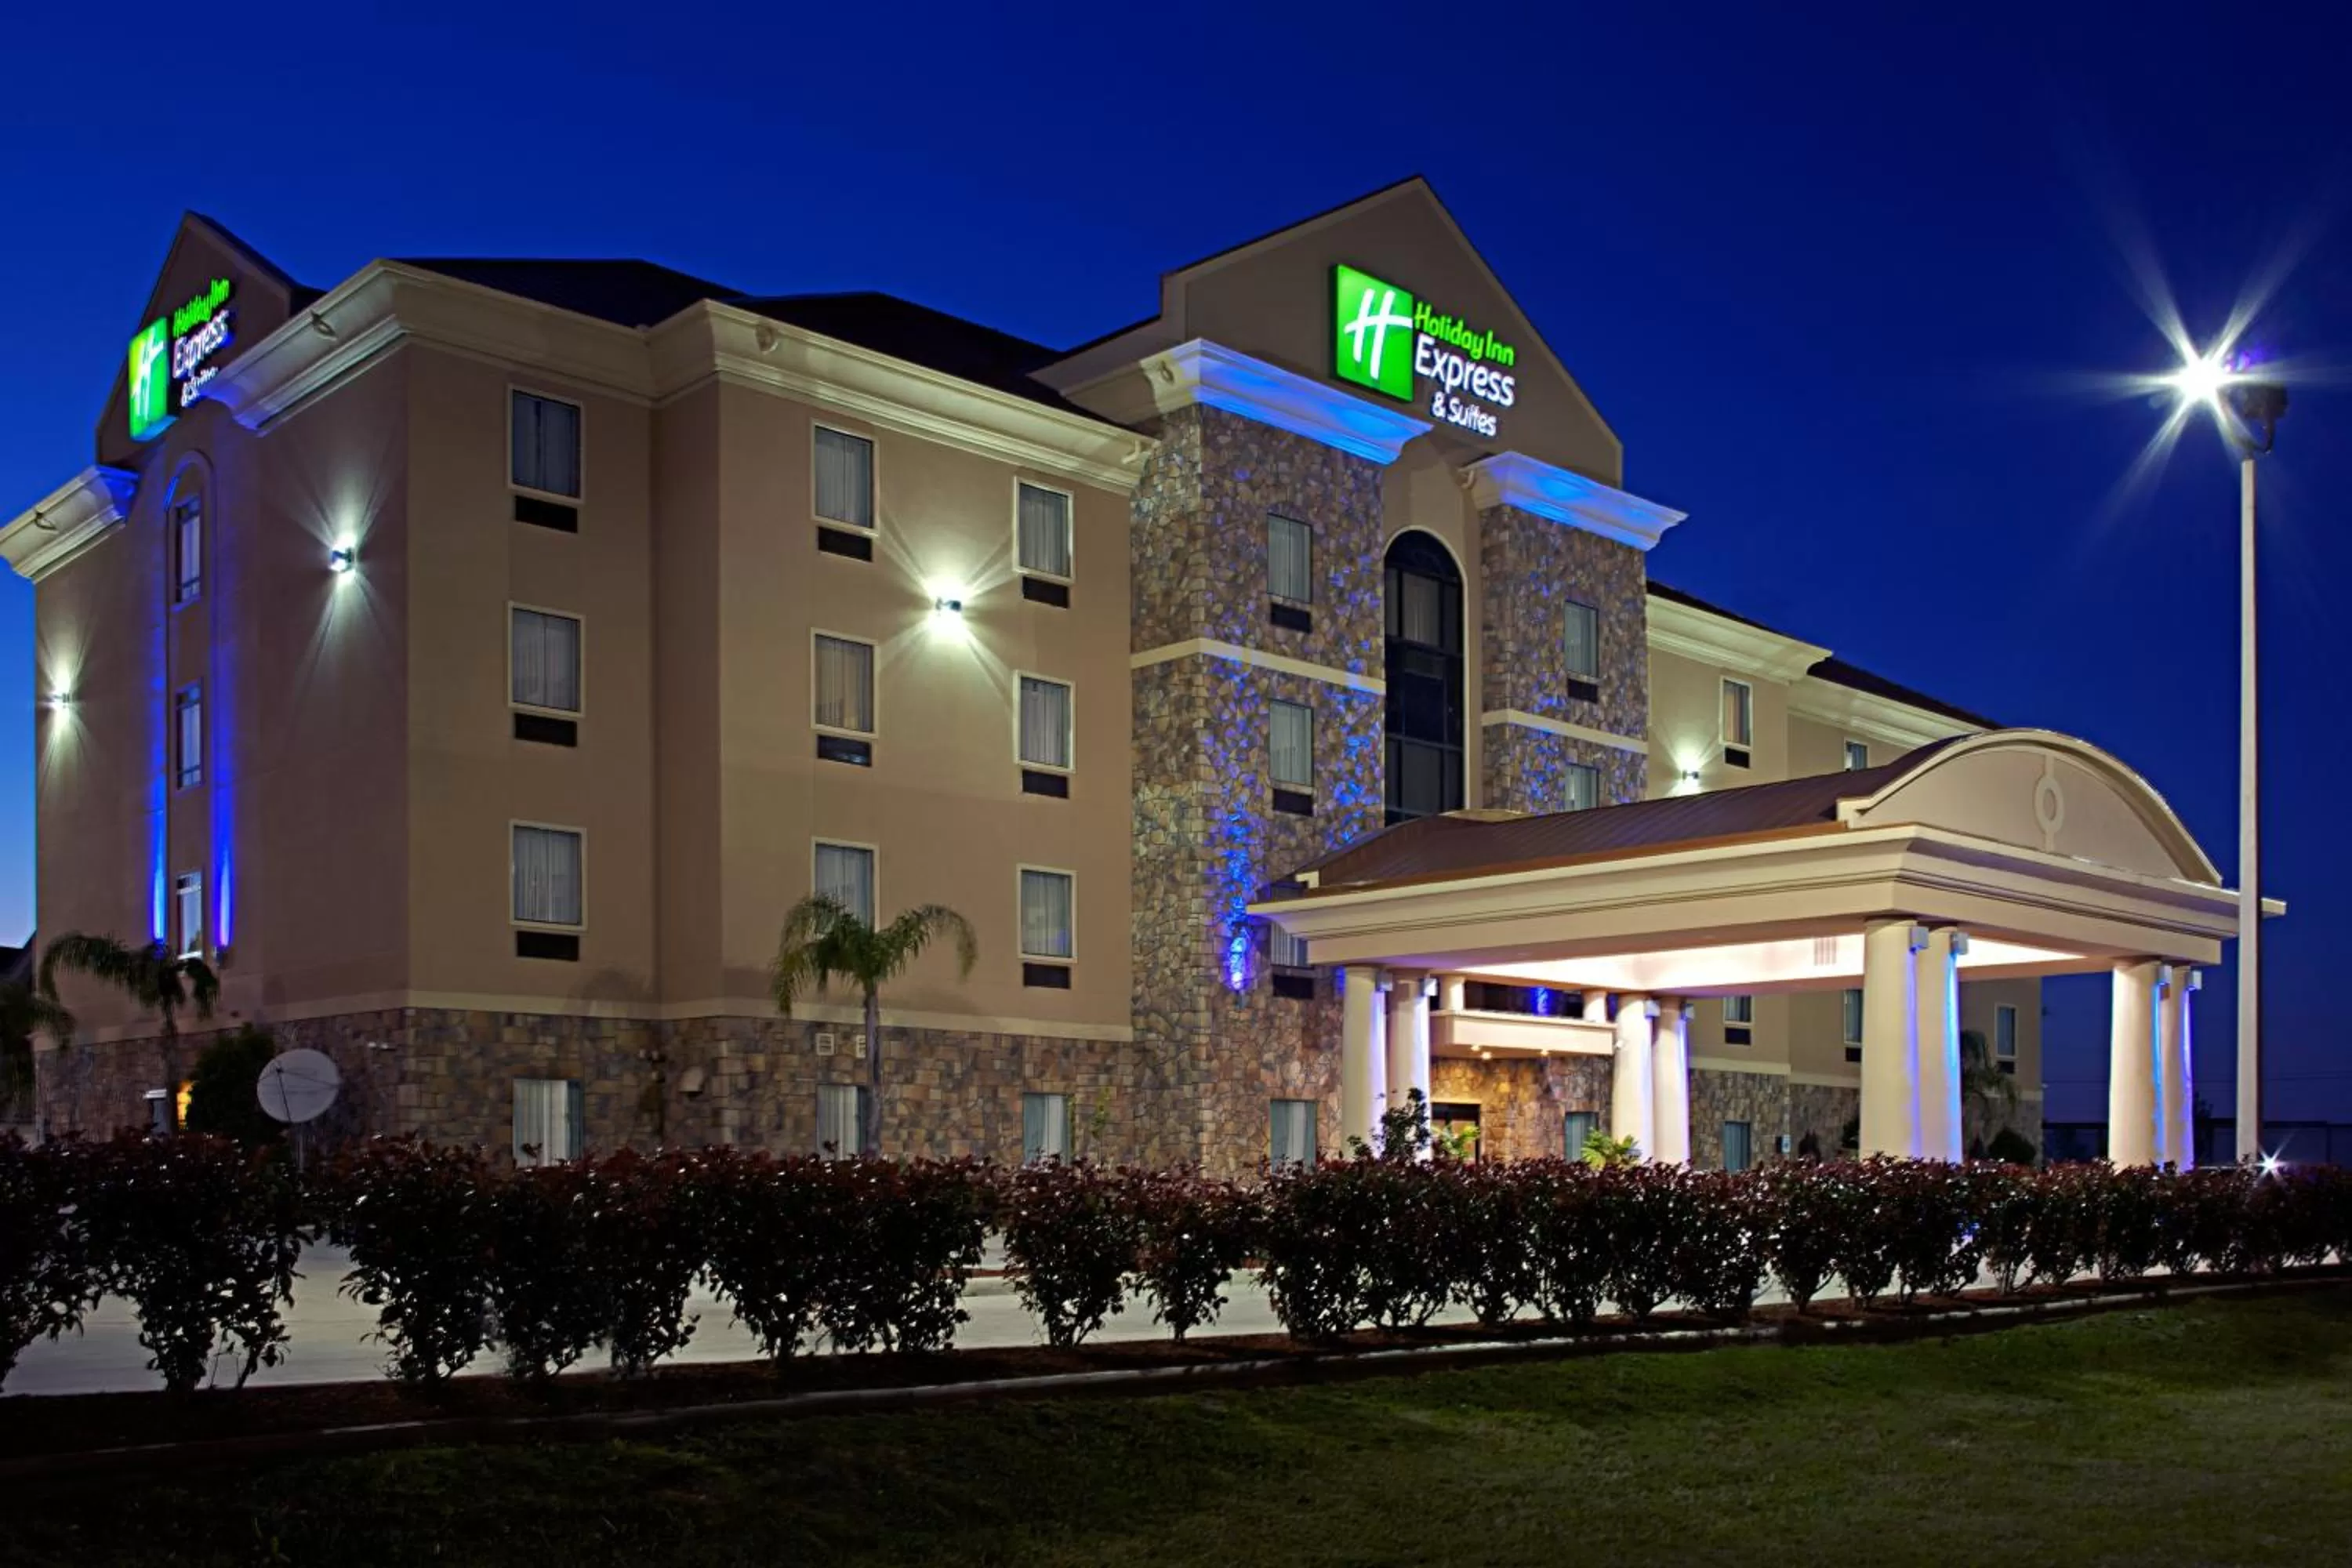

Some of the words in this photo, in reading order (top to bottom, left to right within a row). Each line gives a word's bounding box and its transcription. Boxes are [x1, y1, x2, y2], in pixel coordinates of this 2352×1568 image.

[172, 294, 212, 338] Holiday
[211, 278, 229, 308] Inn
[1414, 301, 1485, 360] Holiday
[1485, 329, 1515, 366] Inn
[172, 309, 229, 379] Express
[1414, 332, 1515, 407] Express
[1432, 391, 1446, 419] &
[1447, 397, 1497, 437] Suites
